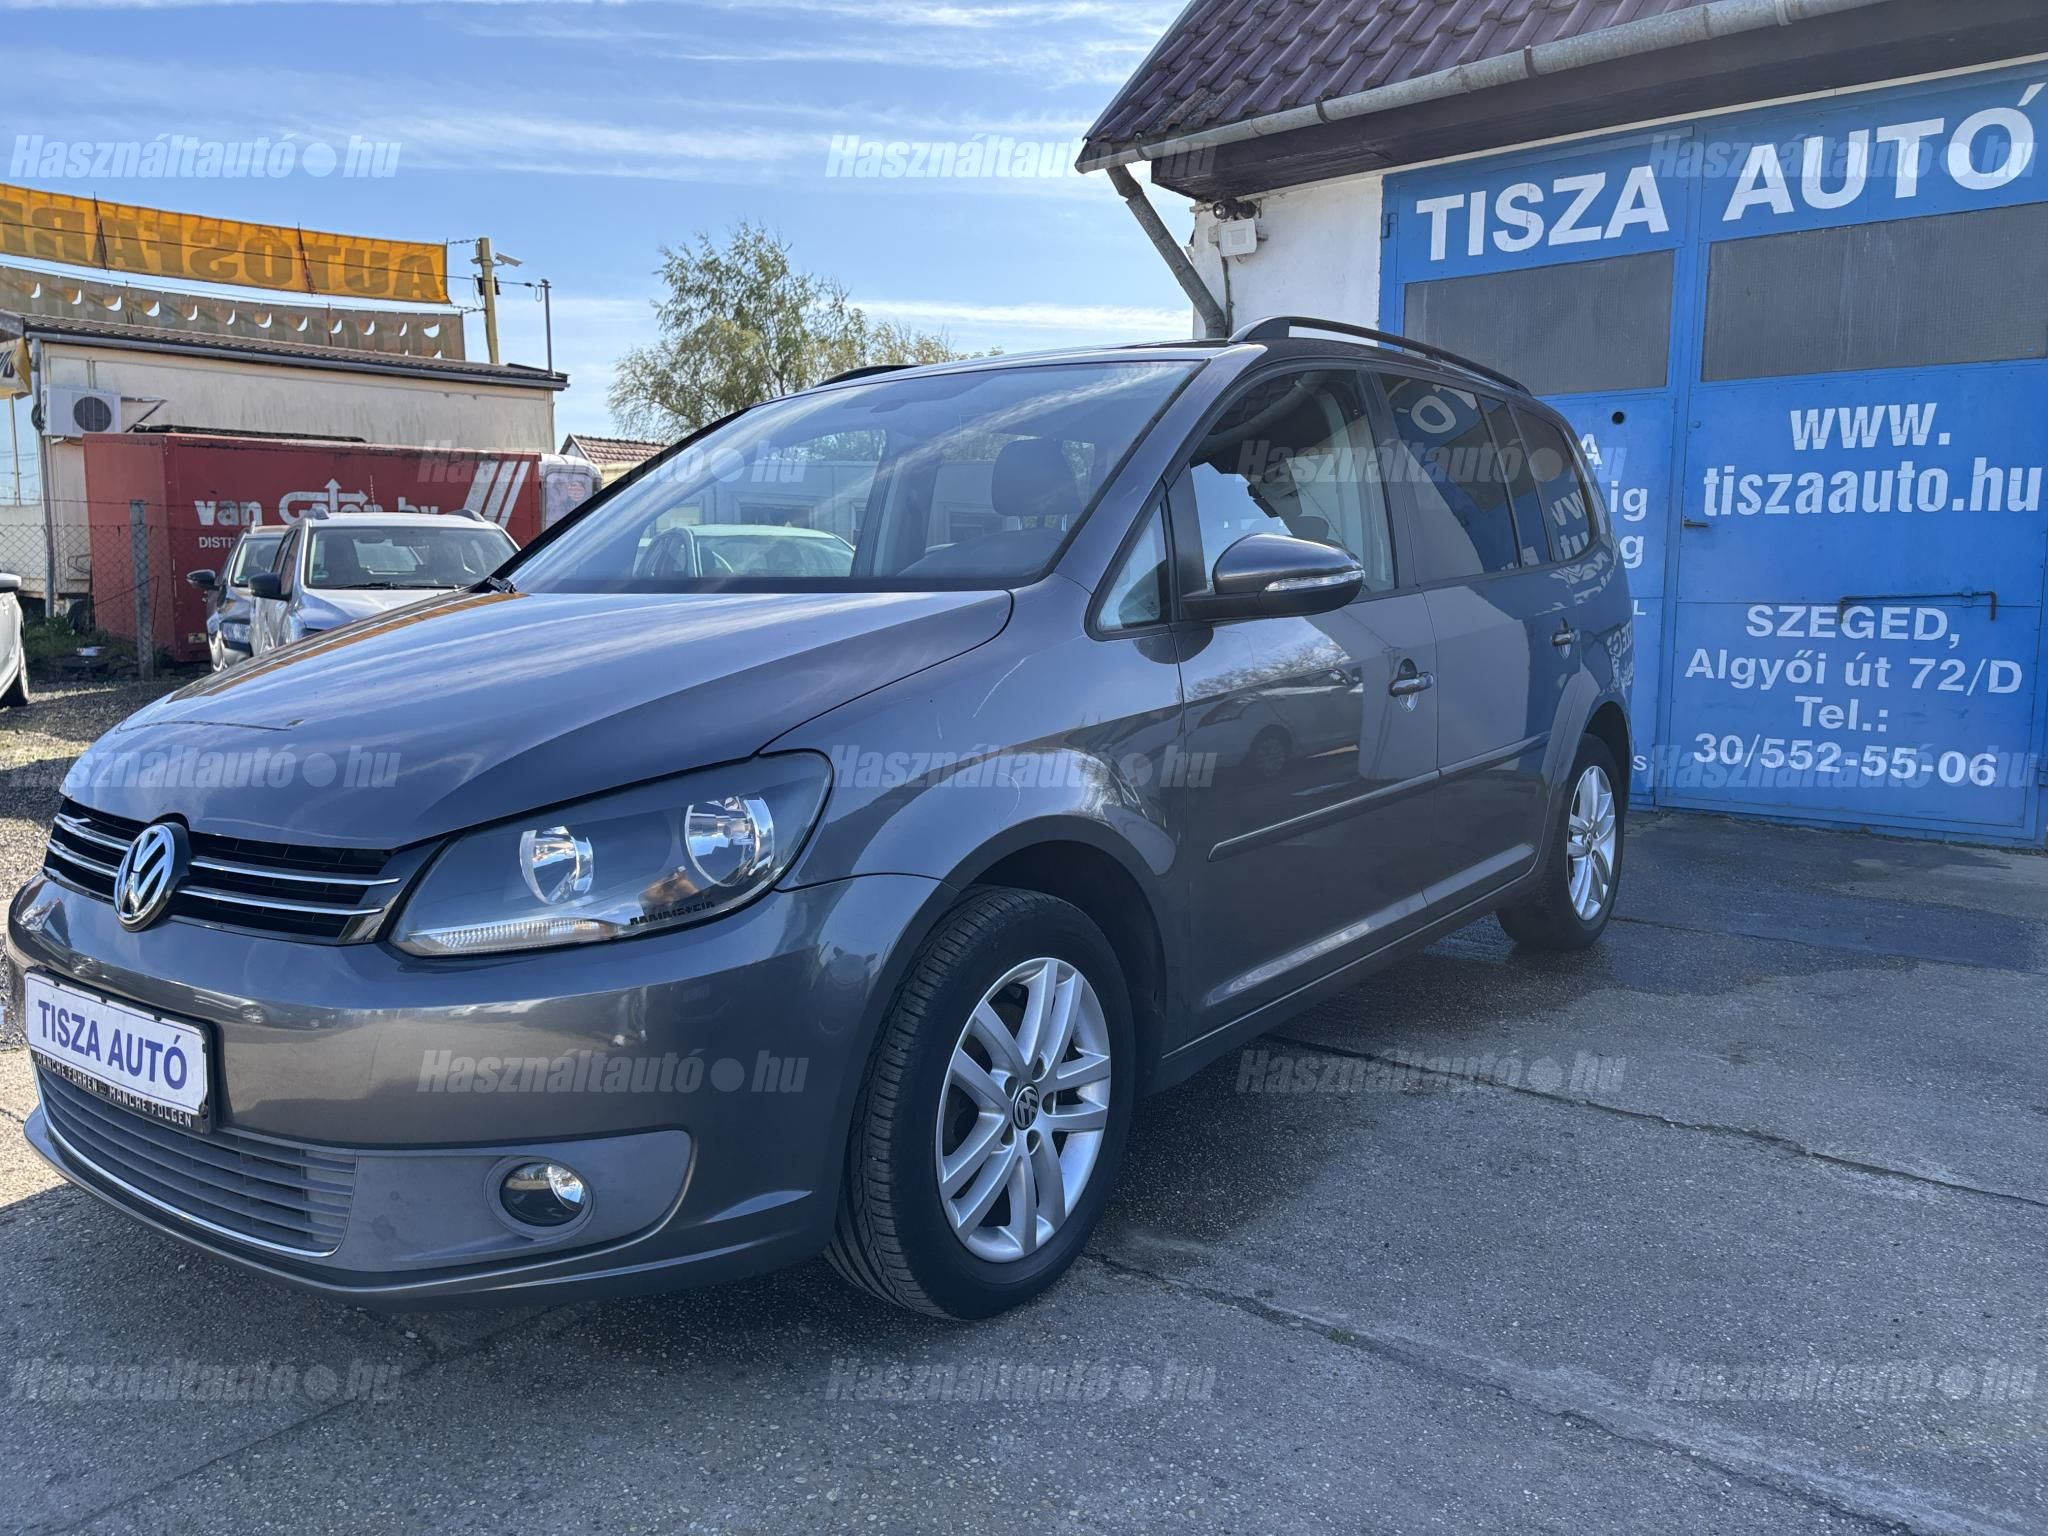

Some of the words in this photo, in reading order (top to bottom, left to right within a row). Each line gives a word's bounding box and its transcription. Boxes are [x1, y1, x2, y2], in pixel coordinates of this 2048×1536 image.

[1416, 165, 1670, 261] TISZA
[1722, 82, 2046, 222] AUTÓ
[1790, 403, 1951, 451] www.
[1703, 457, 2043, 517] tiszaauto.hu
[194, 500, 263, 526] van
[1746, 604, 1961, 649] SZEGED,
[1684, 649, 1827, 691] Algyői
[1844, 652, 1892, 688] út
[1908, 658, 2024, 697] 72/D
[1794, 695, 1890, 733] Tel.:
[1693, 732, 1998, 787] 30/552-55-06
[38, 999, 102, 1063] TISZA
[107, 1034, 188, 1091] AUTÓ
[109, 1085, 148, 1112] MANCHE
[151, 1103, 193, 1129] FOLGEN
